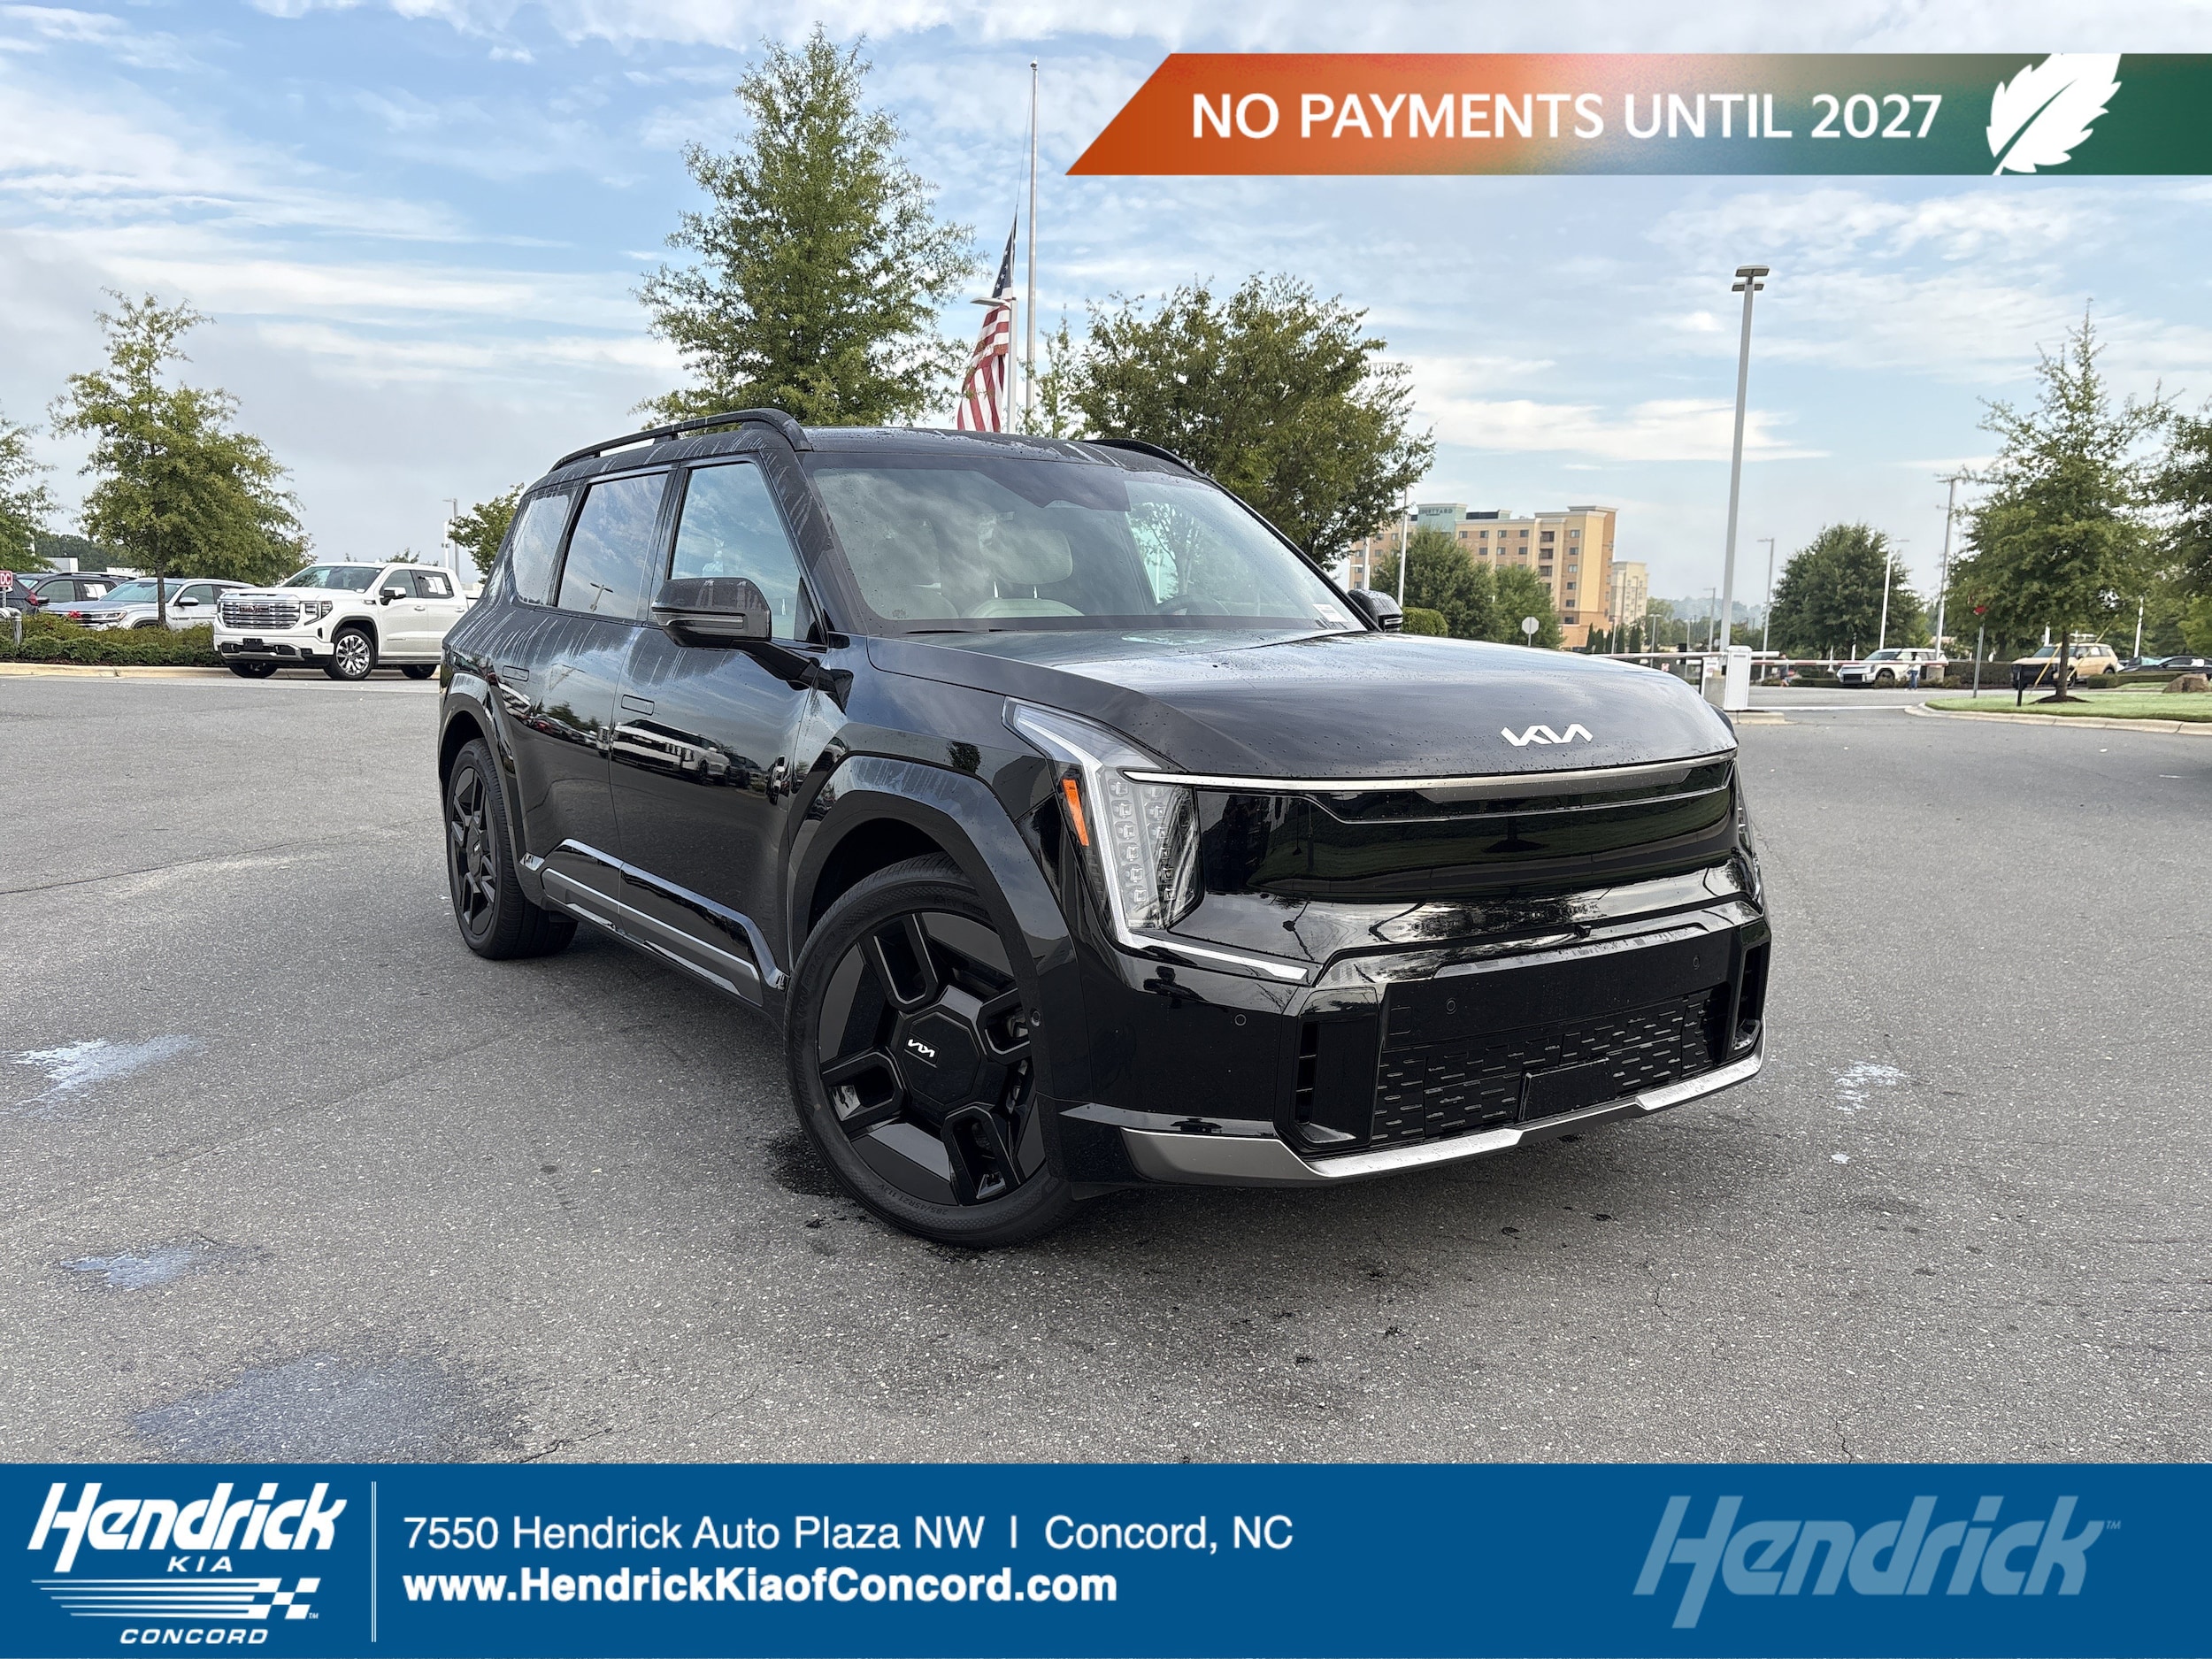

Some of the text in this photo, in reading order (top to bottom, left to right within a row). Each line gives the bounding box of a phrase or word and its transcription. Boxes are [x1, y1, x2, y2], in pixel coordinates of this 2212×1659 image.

[1502, 724, 1594, 747] KIA
[907, 1039, 935, 1058] KIA
[899, 1195, 949, 1216] 285/45R21
